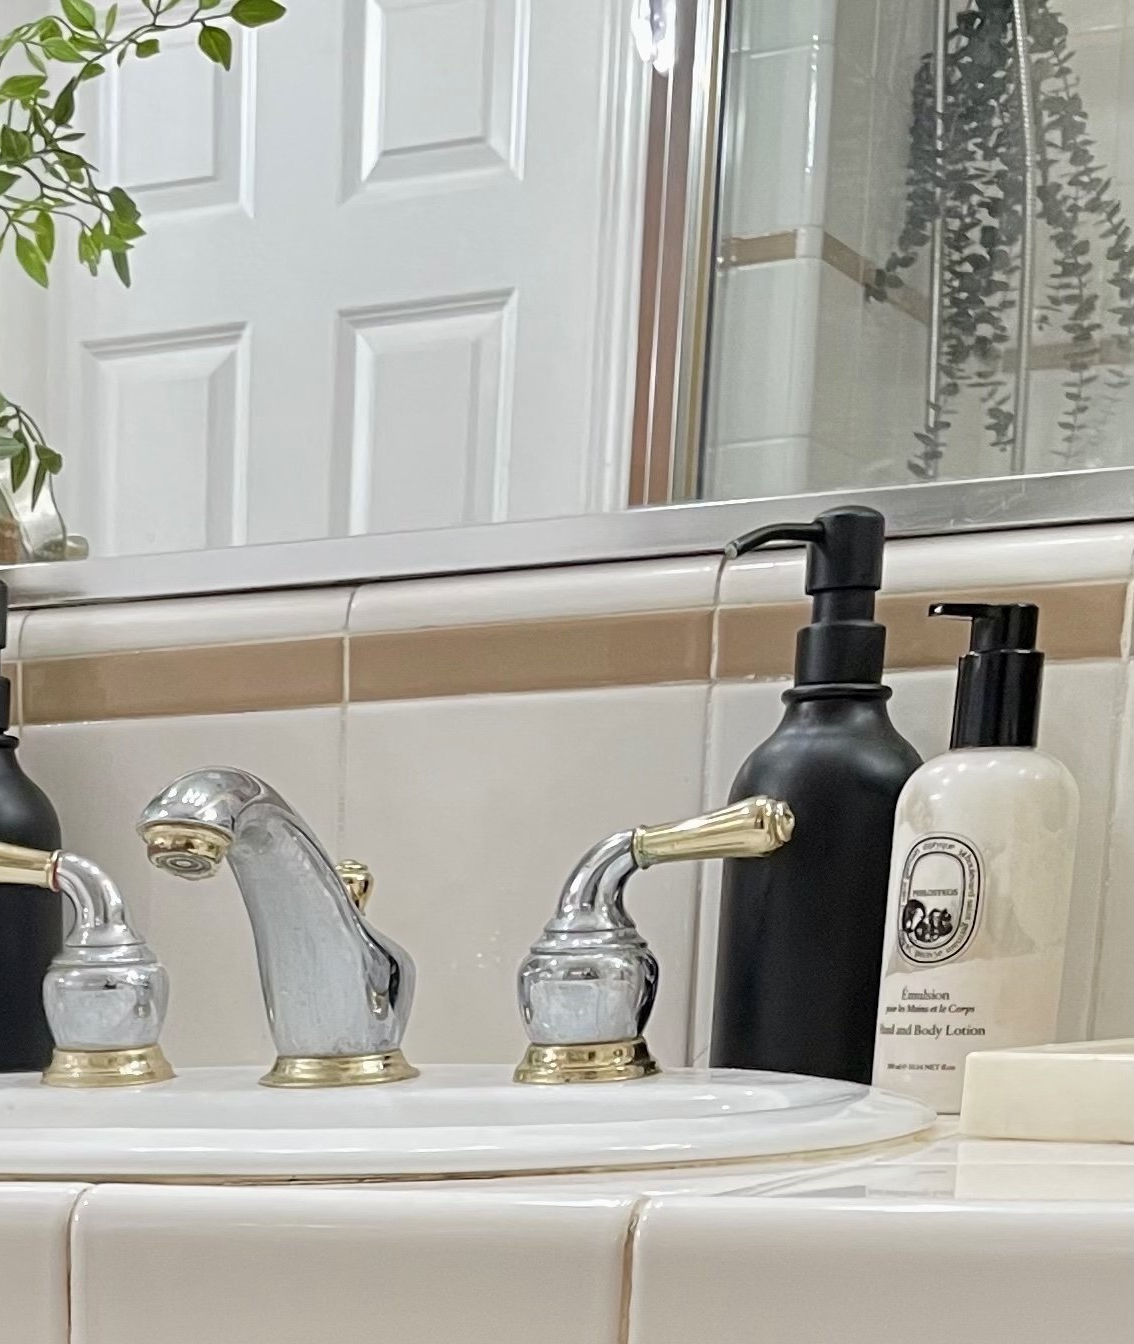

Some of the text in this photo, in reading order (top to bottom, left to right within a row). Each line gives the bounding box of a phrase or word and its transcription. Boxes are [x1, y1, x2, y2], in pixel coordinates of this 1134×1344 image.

[948, 1004, 975, 1016] Corps
[914, 1024, 942, 1040] Body
[946, 1024, 986, 1036] Lotion
